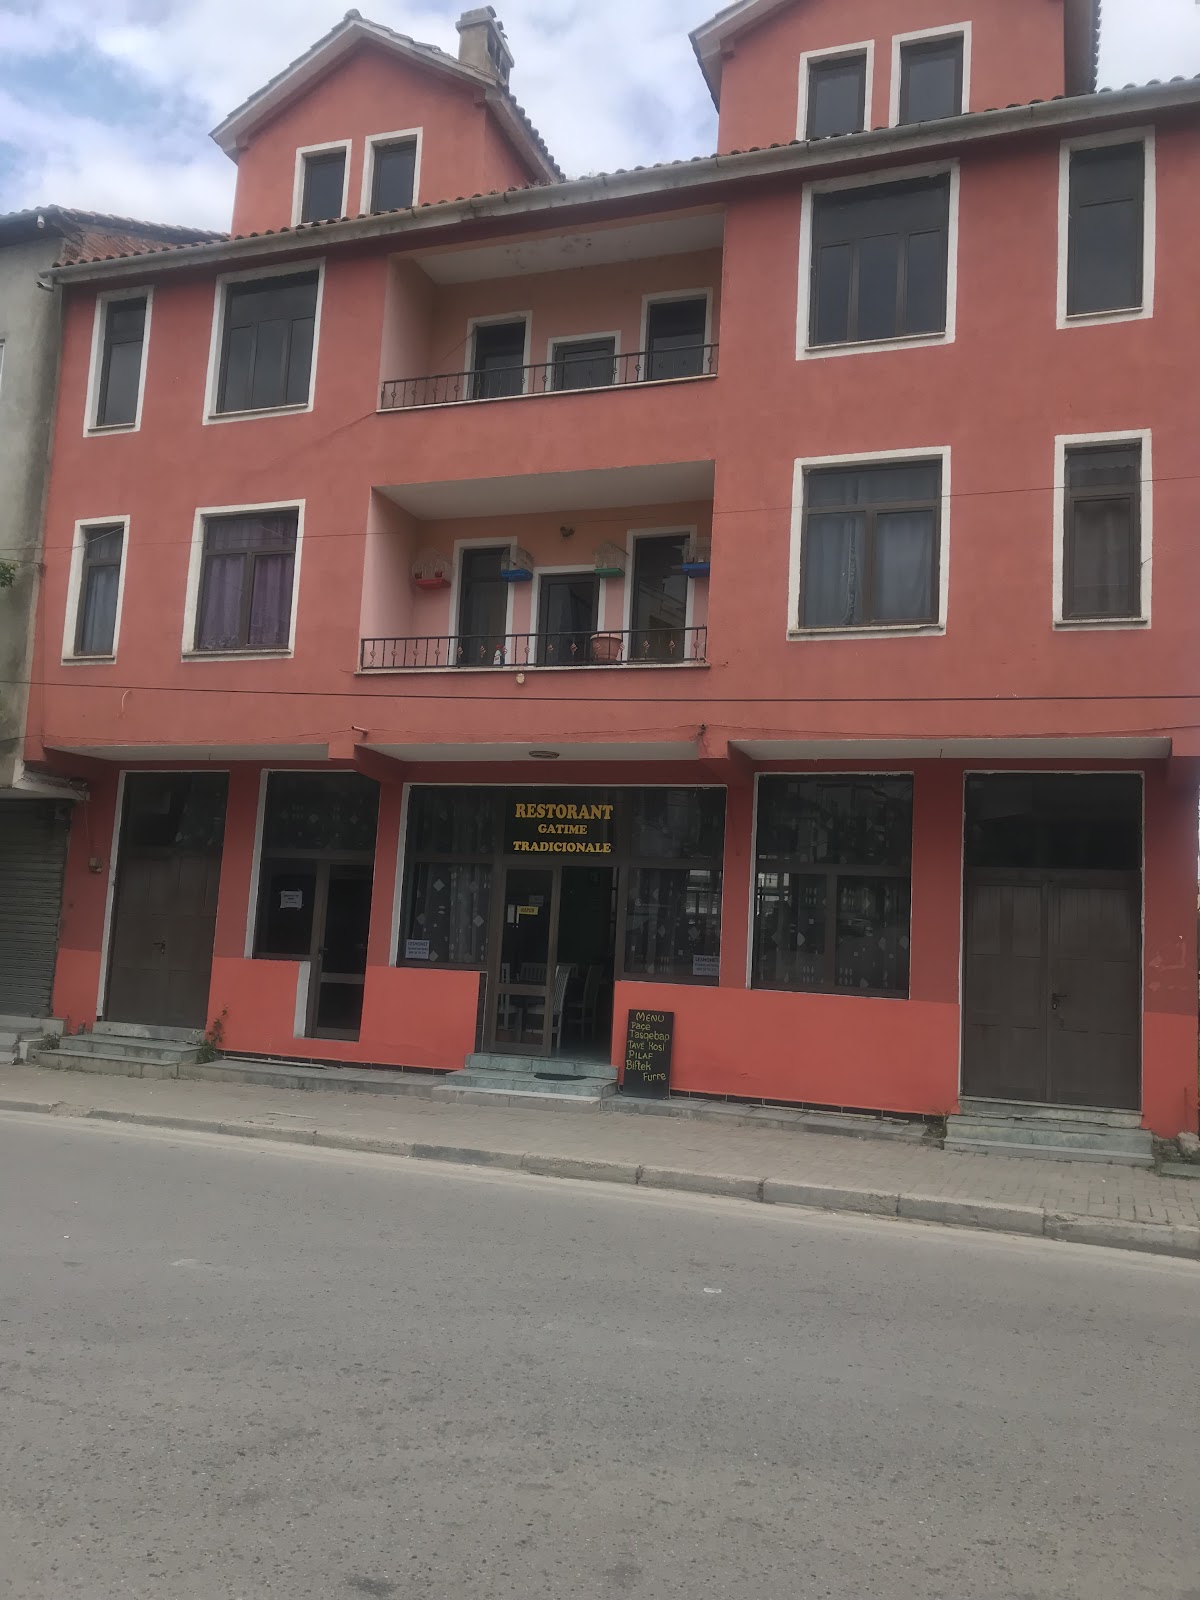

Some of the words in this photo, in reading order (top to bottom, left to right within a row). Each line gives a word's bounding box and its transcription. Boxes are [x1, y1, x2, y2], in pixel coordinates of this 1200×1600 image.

[515, 804, 613, 819] RESTORANT
[538, 824, 588, 834] GATIME
[513, 841, 611, 853] TRADICIONALE
[629, 1030, 670, 1043] Tasqebap
[626, 1060, 651, 1071] Biftek
